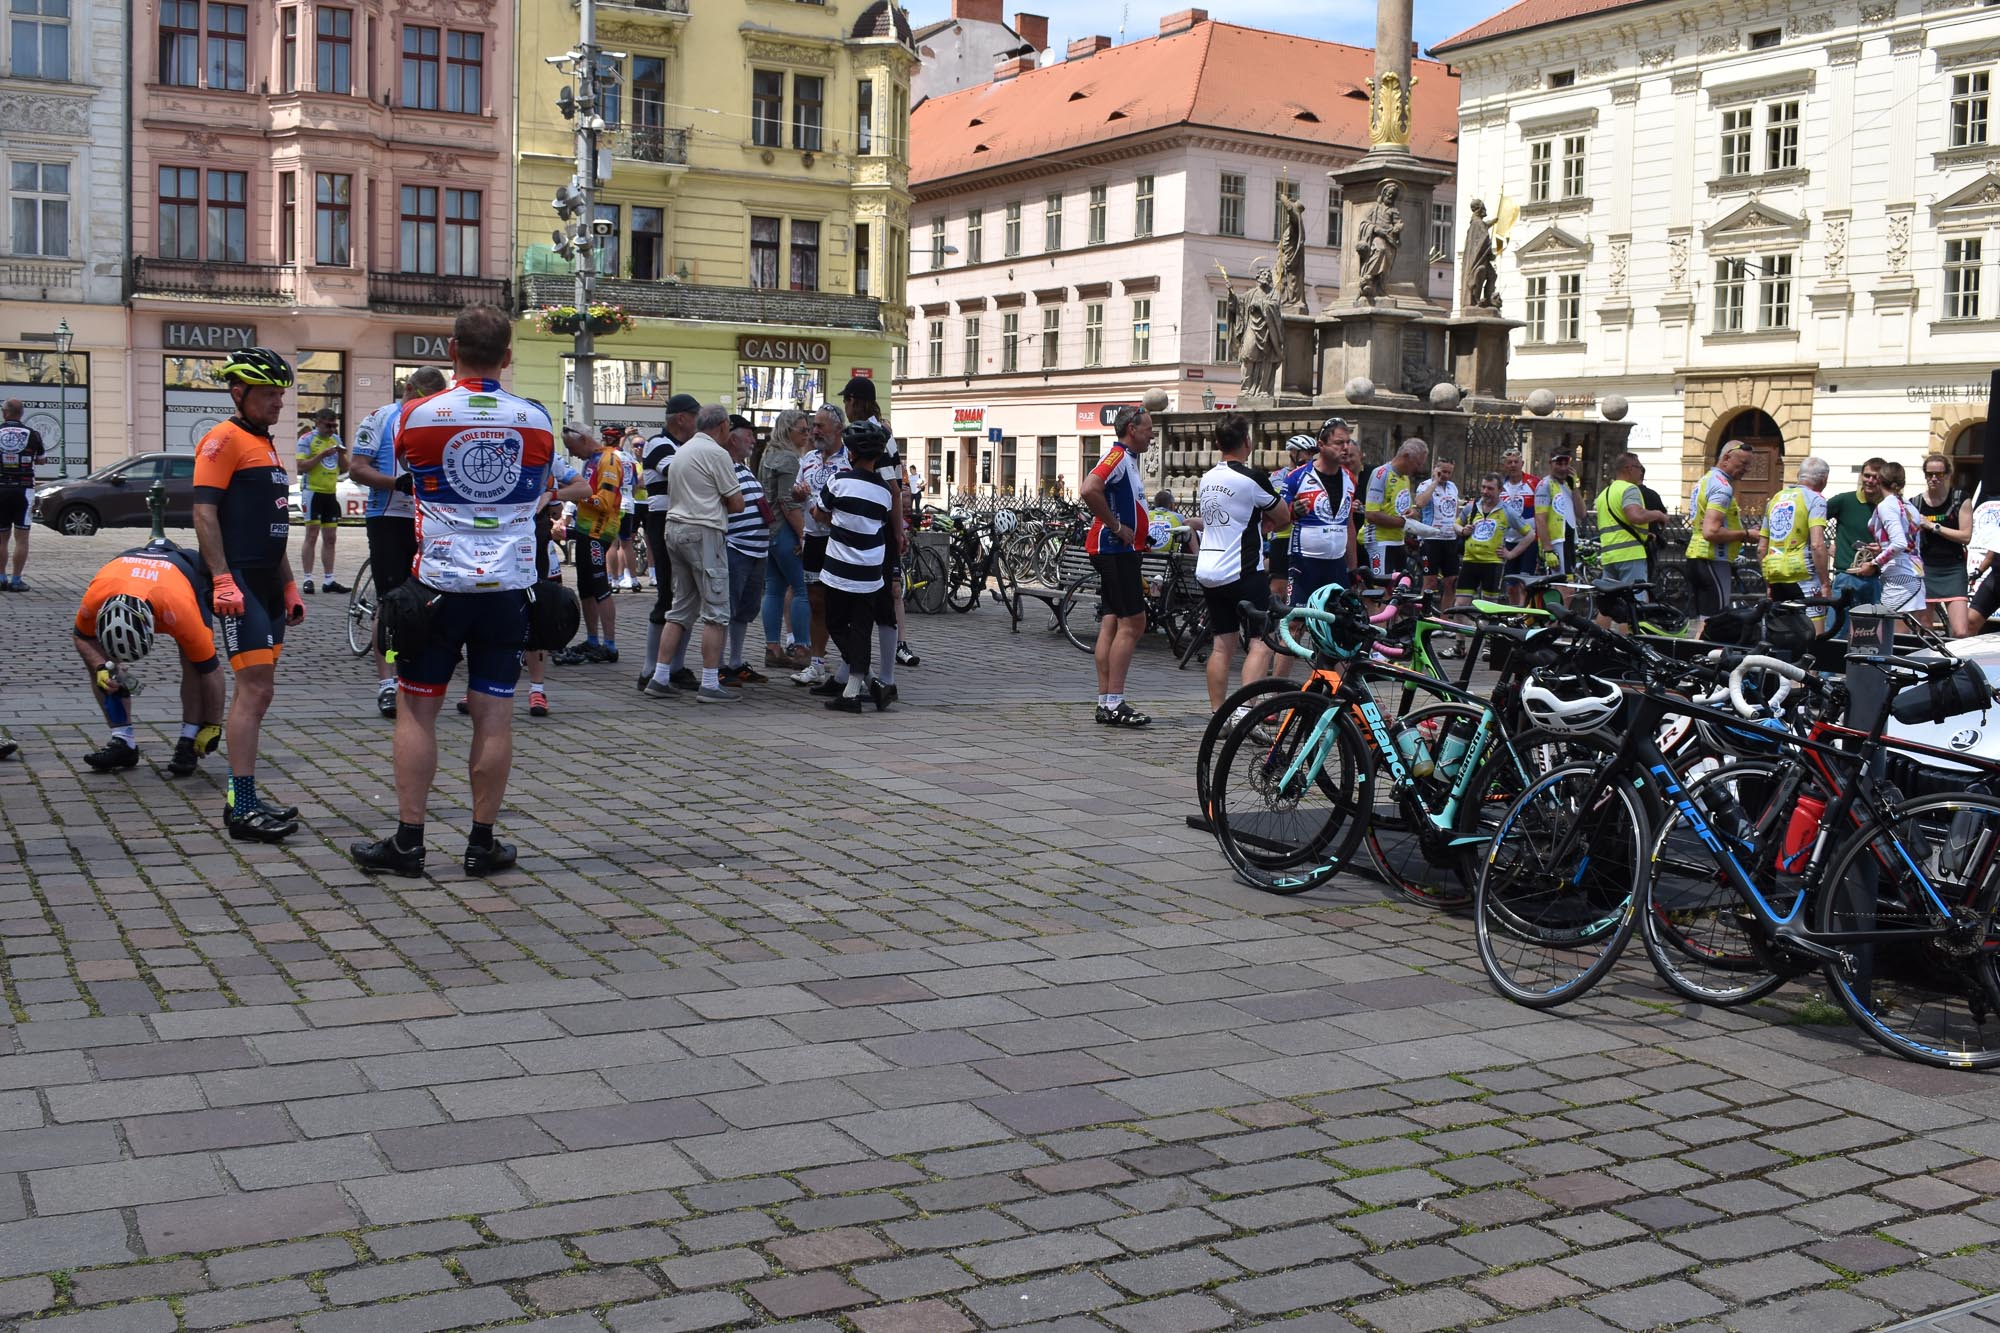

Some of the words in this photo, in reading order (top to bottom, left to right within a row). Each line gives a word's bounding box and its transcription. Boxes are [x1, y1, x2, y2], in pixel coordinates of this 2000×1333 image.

[169, 325, 253, 347] HAPPY
[744, 339, 827, 361] CASINO
[1907, 384, 1958, 397] GALERIE
[168, 405, 205, 413] NONSTOP
[954, 408, 983, 421] ZEMAN
[451, 440, 462, 450] NA
[461, 432, 479, 443] KOLE
[480, 430, 504, 439] DĚTEM
[447, 458, 455, 469] ON
[448, 470, 461, 485] BIKE
[459, 483, 473, 496] FOR
[474, 485, 506, 498] CHILDREN
[591, 540, 600, 566] SMO
[131, 567, 160, 582] MTB
[225, 614, 239, 651] EŽICHOV
[1455, 731, 1482, 788] Bianchi
